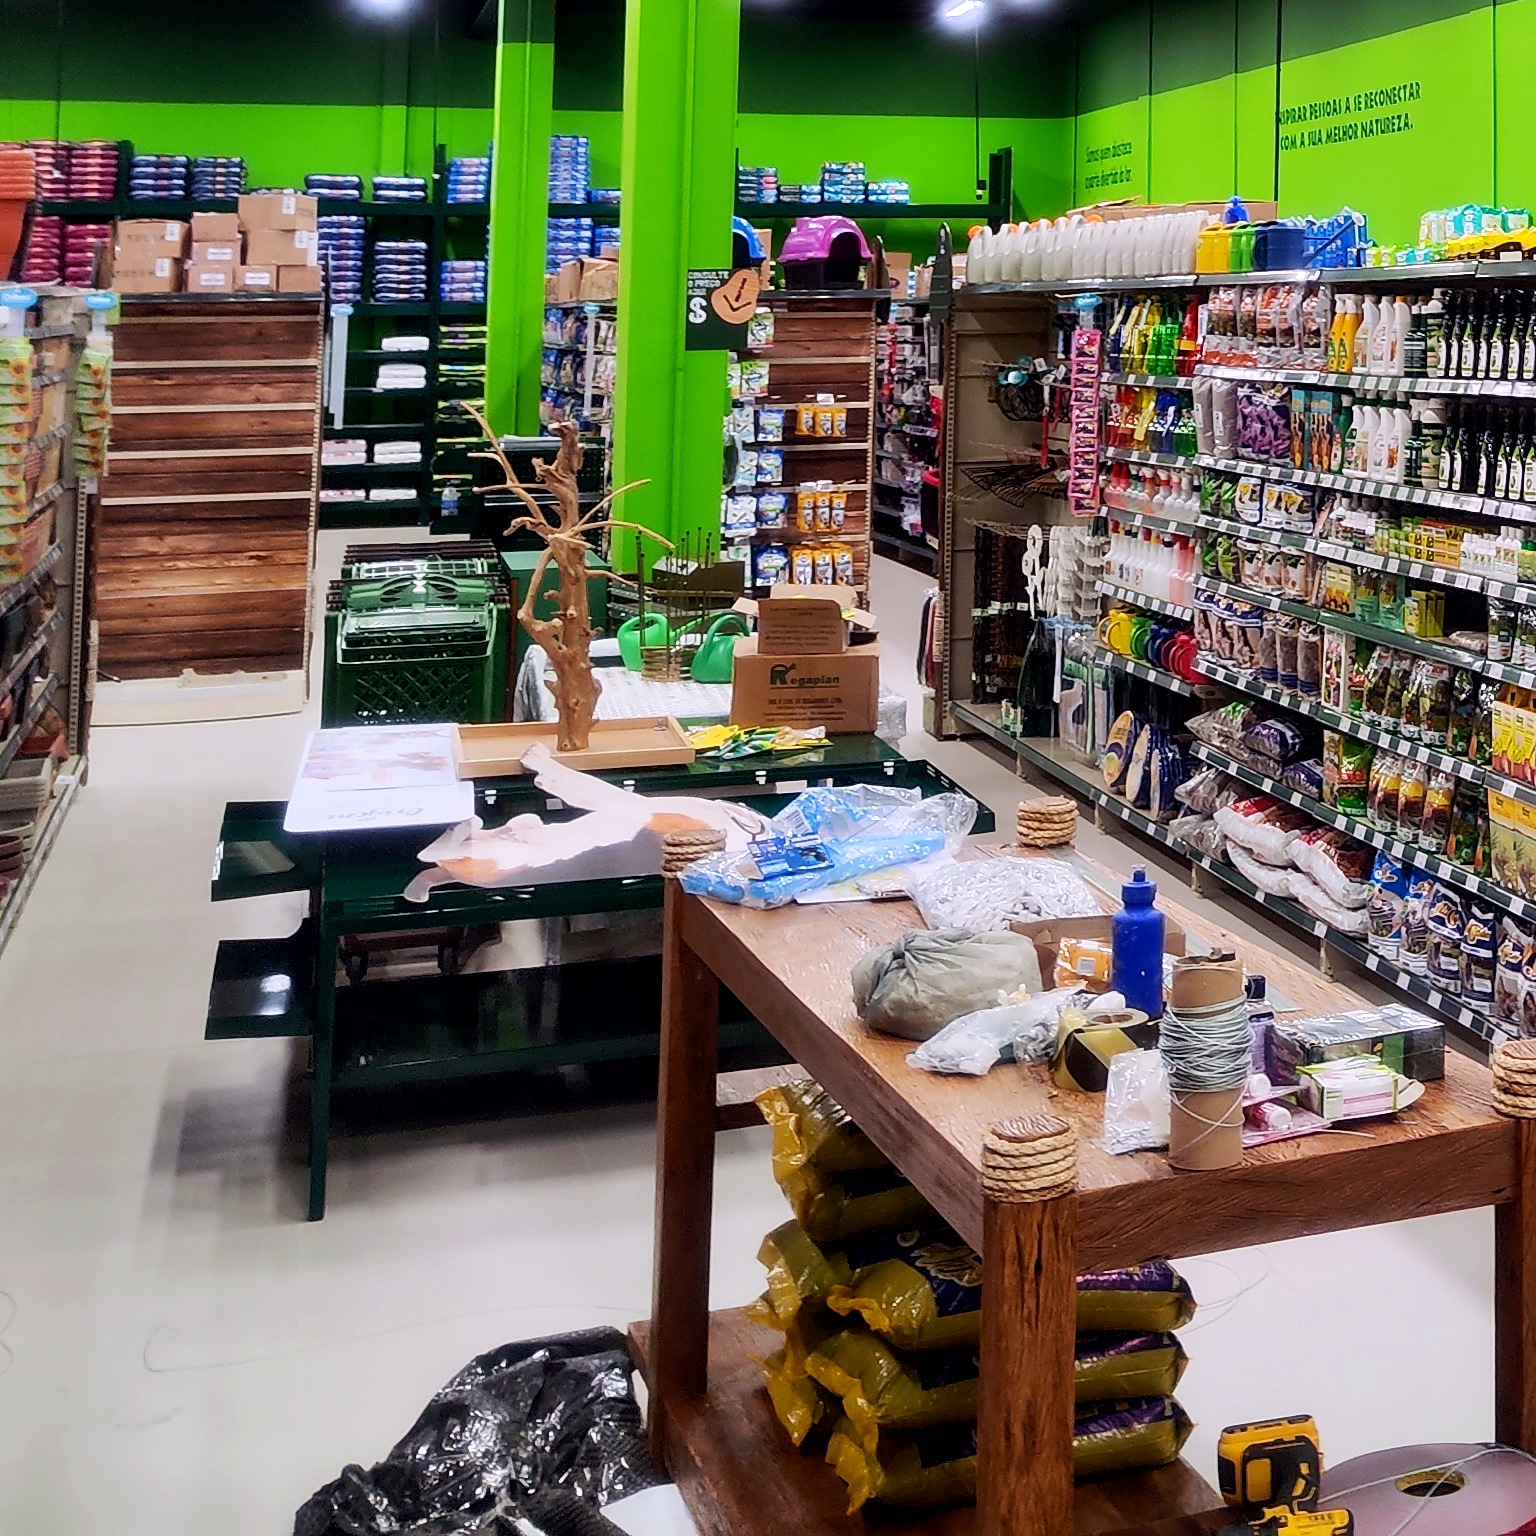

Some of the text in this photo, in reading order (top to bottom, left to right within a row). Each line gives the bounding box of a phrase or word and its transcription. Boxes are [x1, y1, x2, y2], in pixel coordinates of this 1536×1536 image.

[1309, 98, 1342, 121] PESSOAS
[1344, 97, 1351, 114] A
[1354, 94, 1362, 112] SE
[1364, 81, 1421, 110] RECONECTAR
[1280, 112, 1414, 151] COM A SUA MELHOR NATUREZA.
